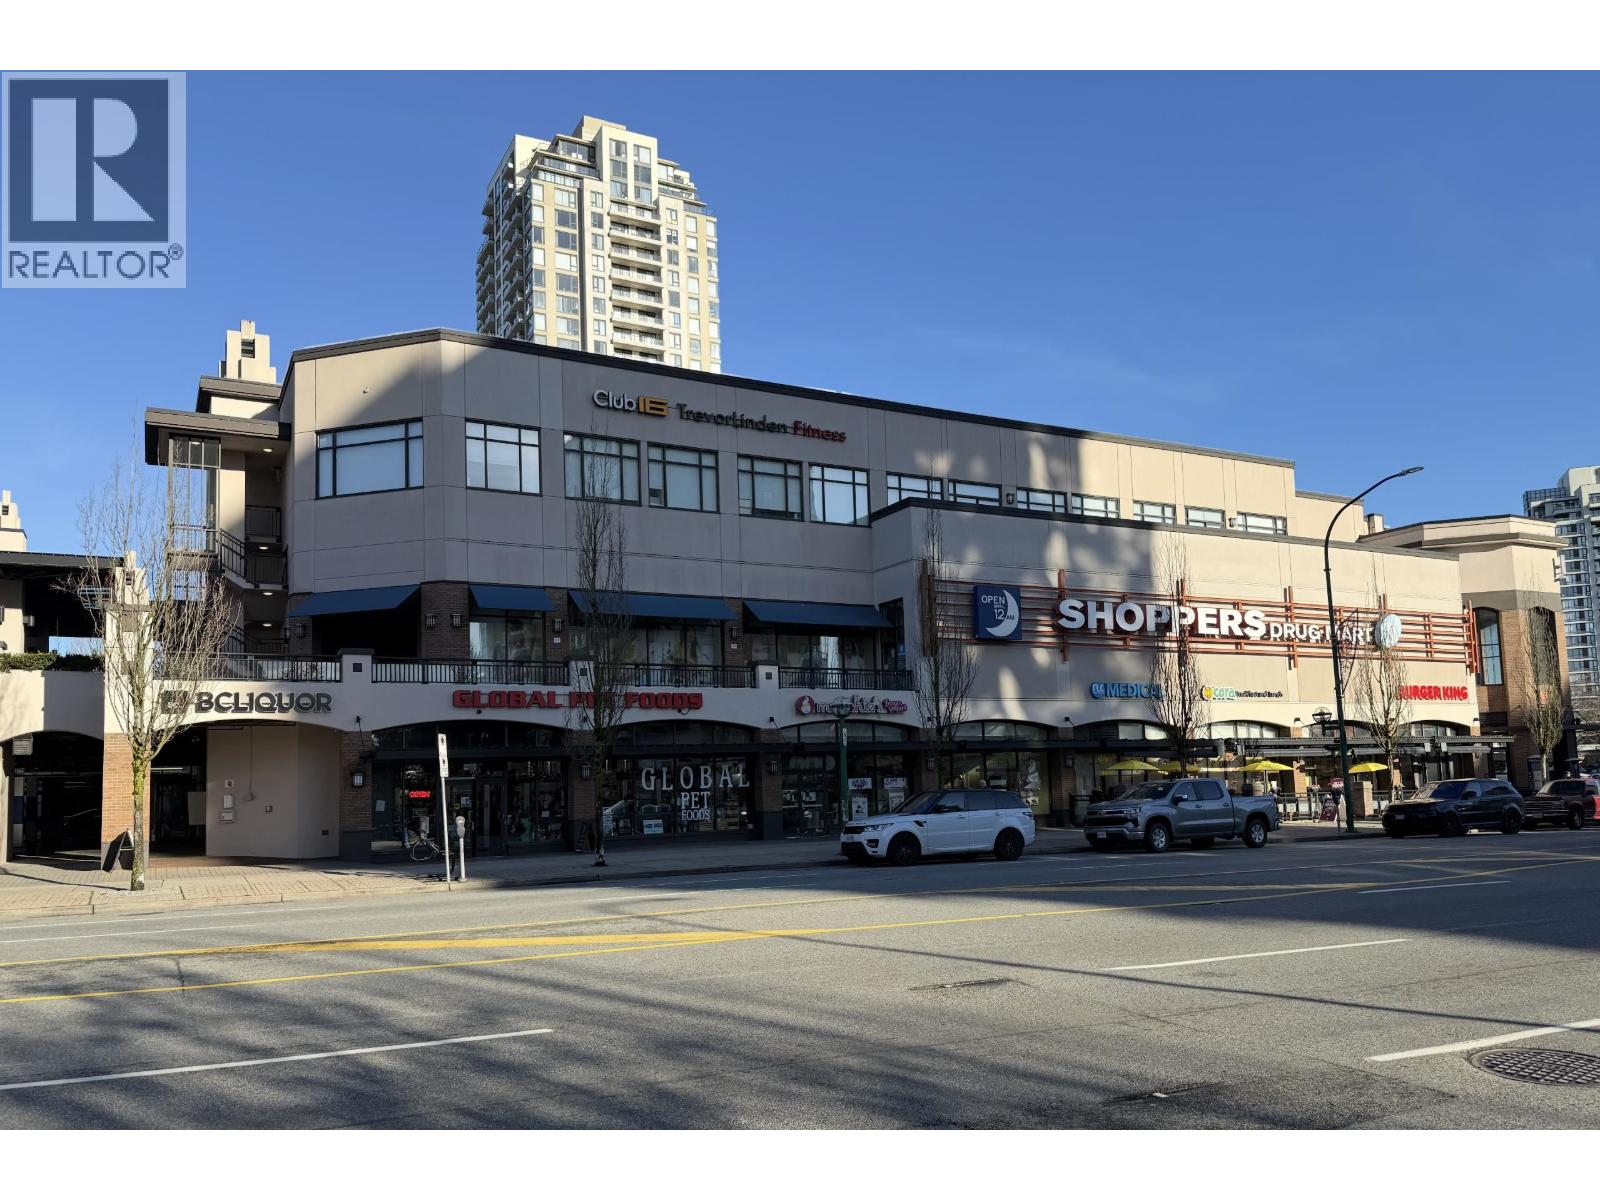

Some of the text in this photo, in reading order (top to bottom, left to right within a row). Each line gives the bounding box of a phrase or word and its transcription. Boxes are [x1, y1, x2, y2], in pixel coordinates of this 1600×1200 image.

[793, 420, 847, 442] Fitness
[981, 595, 1006, 605] OPEN
[994, 608, 1006, 620] 12
[1057, 599, 1266, 637] SHOPPERS
[1269, 622, 1321, 641] DRUG
[453, 690, 563, 709] GLOBAL
[624, 692, 703, 710] FOODS
[1442, 686, 1469, 701] KING
[641, 762, 750, 791] GLOBAL
[680, 791, 711, 810] PET
[681, 809, 711, 821] FOODS
